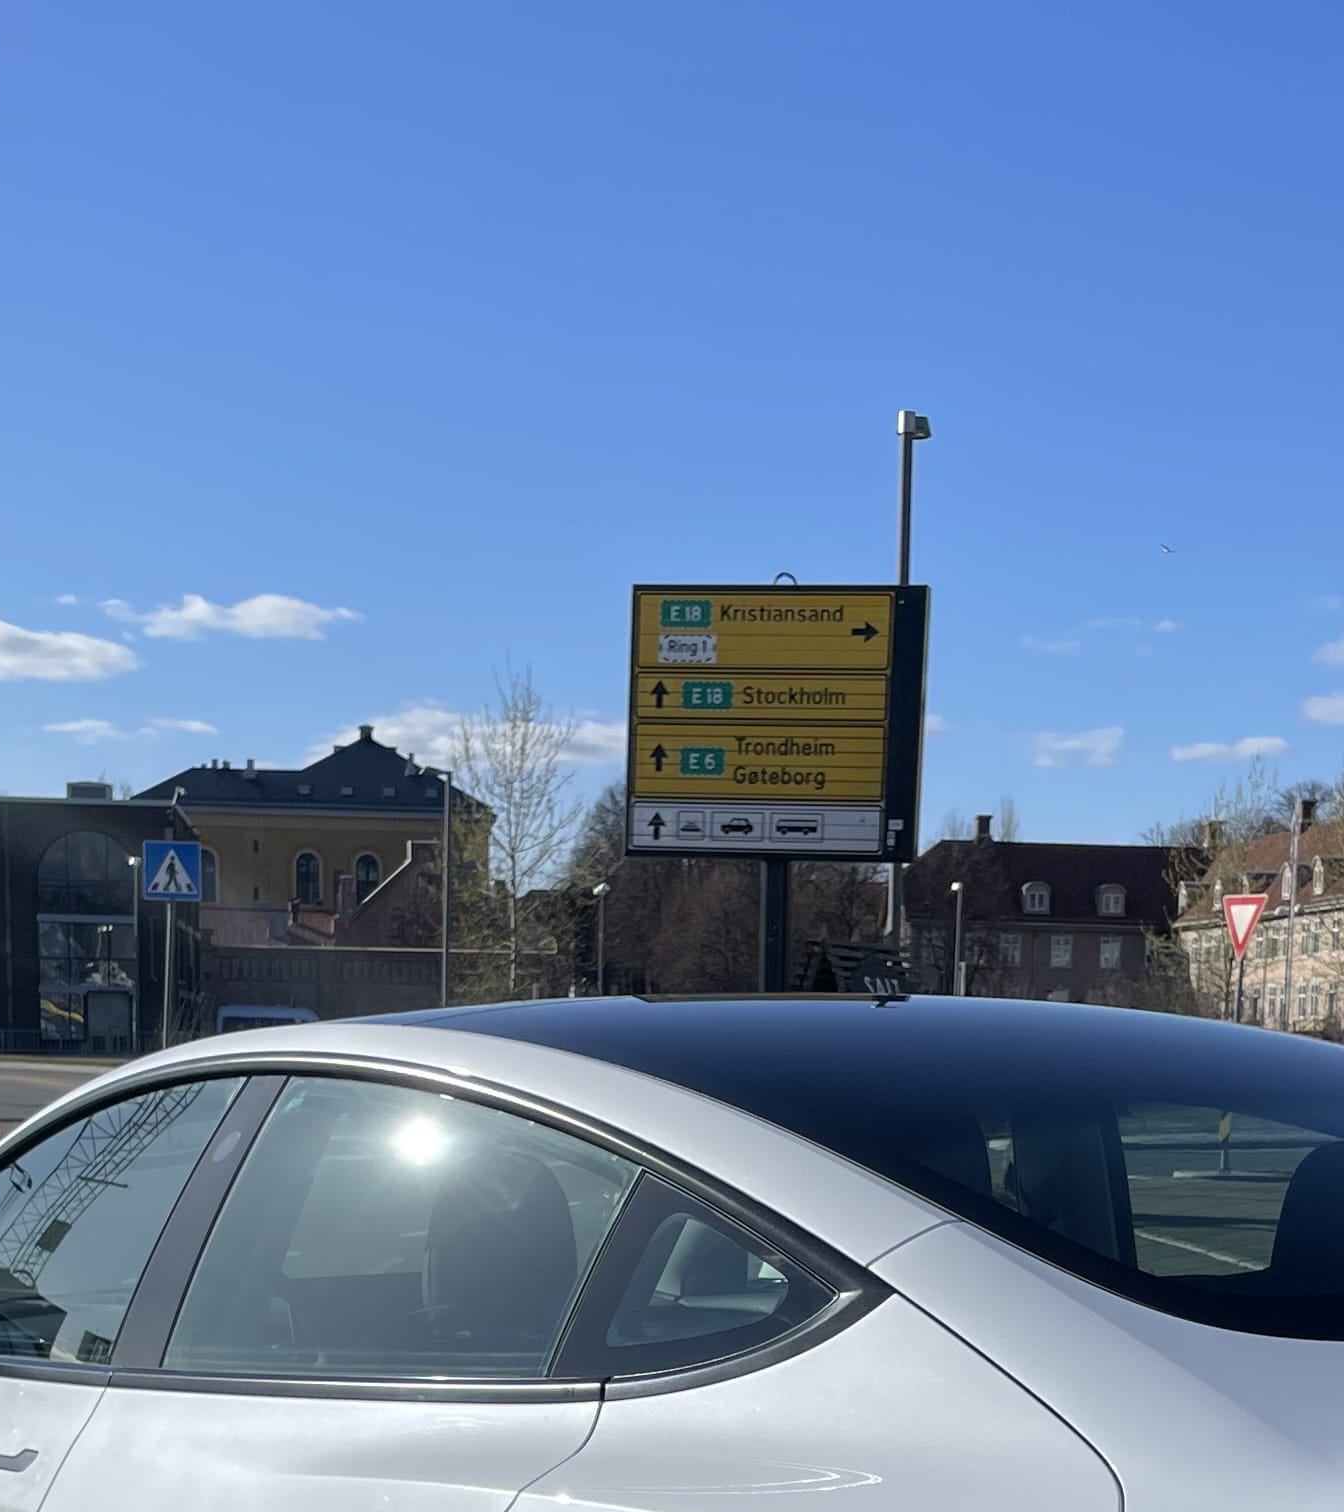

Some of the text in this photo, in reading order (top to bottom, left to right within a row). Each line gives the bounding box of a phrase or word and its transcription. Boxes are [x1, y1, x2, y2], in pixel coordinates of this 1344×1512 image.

[670, 606, 702, 621] E 18
[719, 604, 844, 622] Kristiansand
[667, 640, 698, 656] Ring
[691, 688, 723, 704] E 18
[742, 686, 846, 705] Stockholm
[735, 736, 835, 757] Trondheim
[688, 753, 716, 769] E 6
